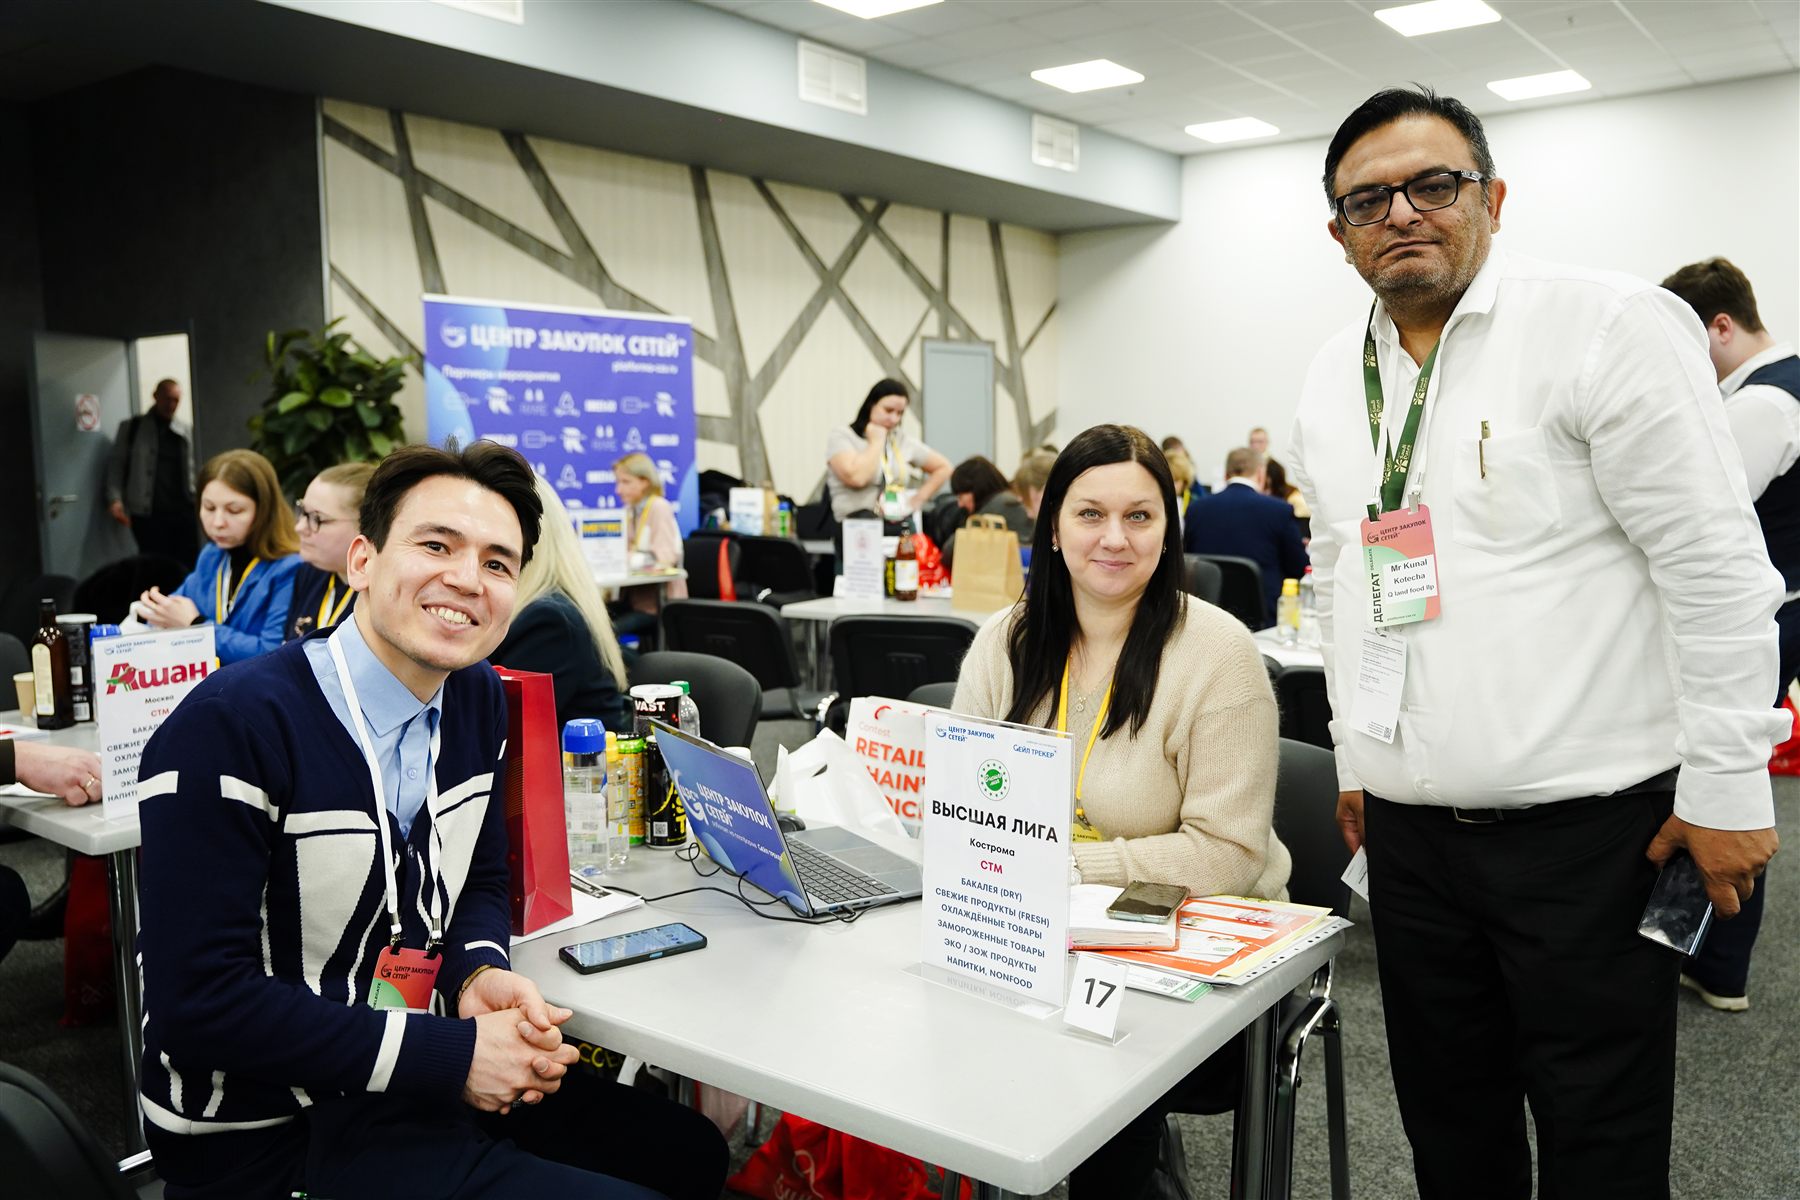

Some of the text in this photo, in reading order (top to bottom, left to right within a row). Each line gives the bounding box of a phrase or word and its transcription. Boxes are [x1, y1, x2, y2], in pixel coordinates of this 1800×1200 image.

[471, 324, 680, 358] ЦЕНТР ЗАКУПОК СЕТЕЙ
[1380, 520, 1426, 535] ЦЕНТР ЗАКУПОК
[1381, 533, 1397, 541] СЕТЕЙ
[1391, 559, 1428, 572] Mr Kunal
[1394, 573, 1426, 584] Kotecha
[1371, 573, 1383, 623] ДЕЛЕГАТ
[1394, 589, 1408, 597] land
[106, 661, 208, 695] Ашан
[144, 695, 174, 704] Москва
[151, 708, 170, 717] СТМ
[132, 724, 161, 734] БАКАЛ
[858, 721, 891, 737] Contest
[948, 726, 995, 740] ЦЕНТР ЗАКУПОК
[948, 733, 966, 742] СЕТЕЙ
[107, 740, 140, 752] СВЕЖИЕ
[856, 736, 926, 769] RETAIL
[696, 781, 772, 830] ЦЕНТР ЗАКУПОК
[705, 803, 733, 827] СЕТЕЙ
[932, 800, 1058, 843] ВЫСШАЯ ЛИГА
[969, 837, 1015, 857] Кострома
[980, 860, 1003, 874] СТМ
[961, 877, 1022, 903] БАКАЛЕЯ (DRY)
[935, 887, 1050, 928] СВЕЖИЕ ПРОДУКТЫ (FRESH)
[941, 903, 1042, 940] ОХЛАЖДЁННЫЕ ТОВАРЫ
[937, 919, 1045, 958] ЗАМОРОЖЕННЫЕ ТОВАРЫ
[944, 938, 961, 950] ЭКО
[969, 946, 988, 958] ЗОЖ
[990, 952, 1037, 973] ПРОДУКТЫ
[394, 965, 434, 976] ЦЕНТР ЗАКУПОК
[947, 955, 1033, 990] НАПИТКИ, NONFOOD
[1085, 977, 1117, 1009] 17
